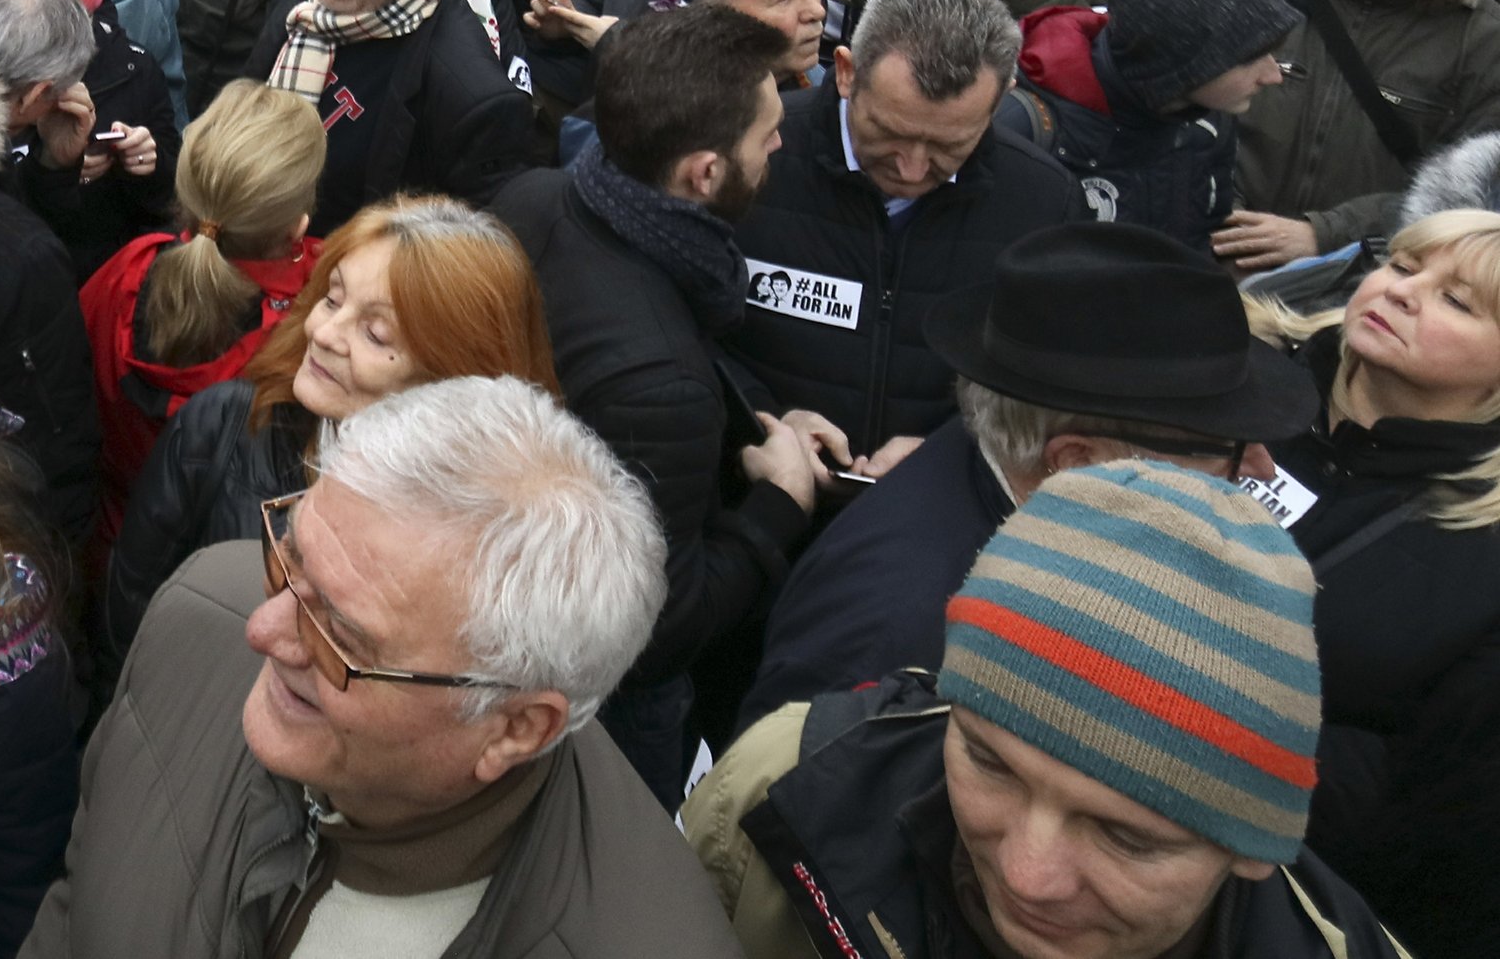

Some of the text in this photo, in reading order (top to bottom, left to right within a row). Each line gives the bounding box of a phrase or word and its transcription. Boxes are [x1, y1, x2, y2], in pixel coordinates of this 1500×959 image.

[795, 276, 838, 300] #ALL
[791, 293, 853, 321] FOR JAN
